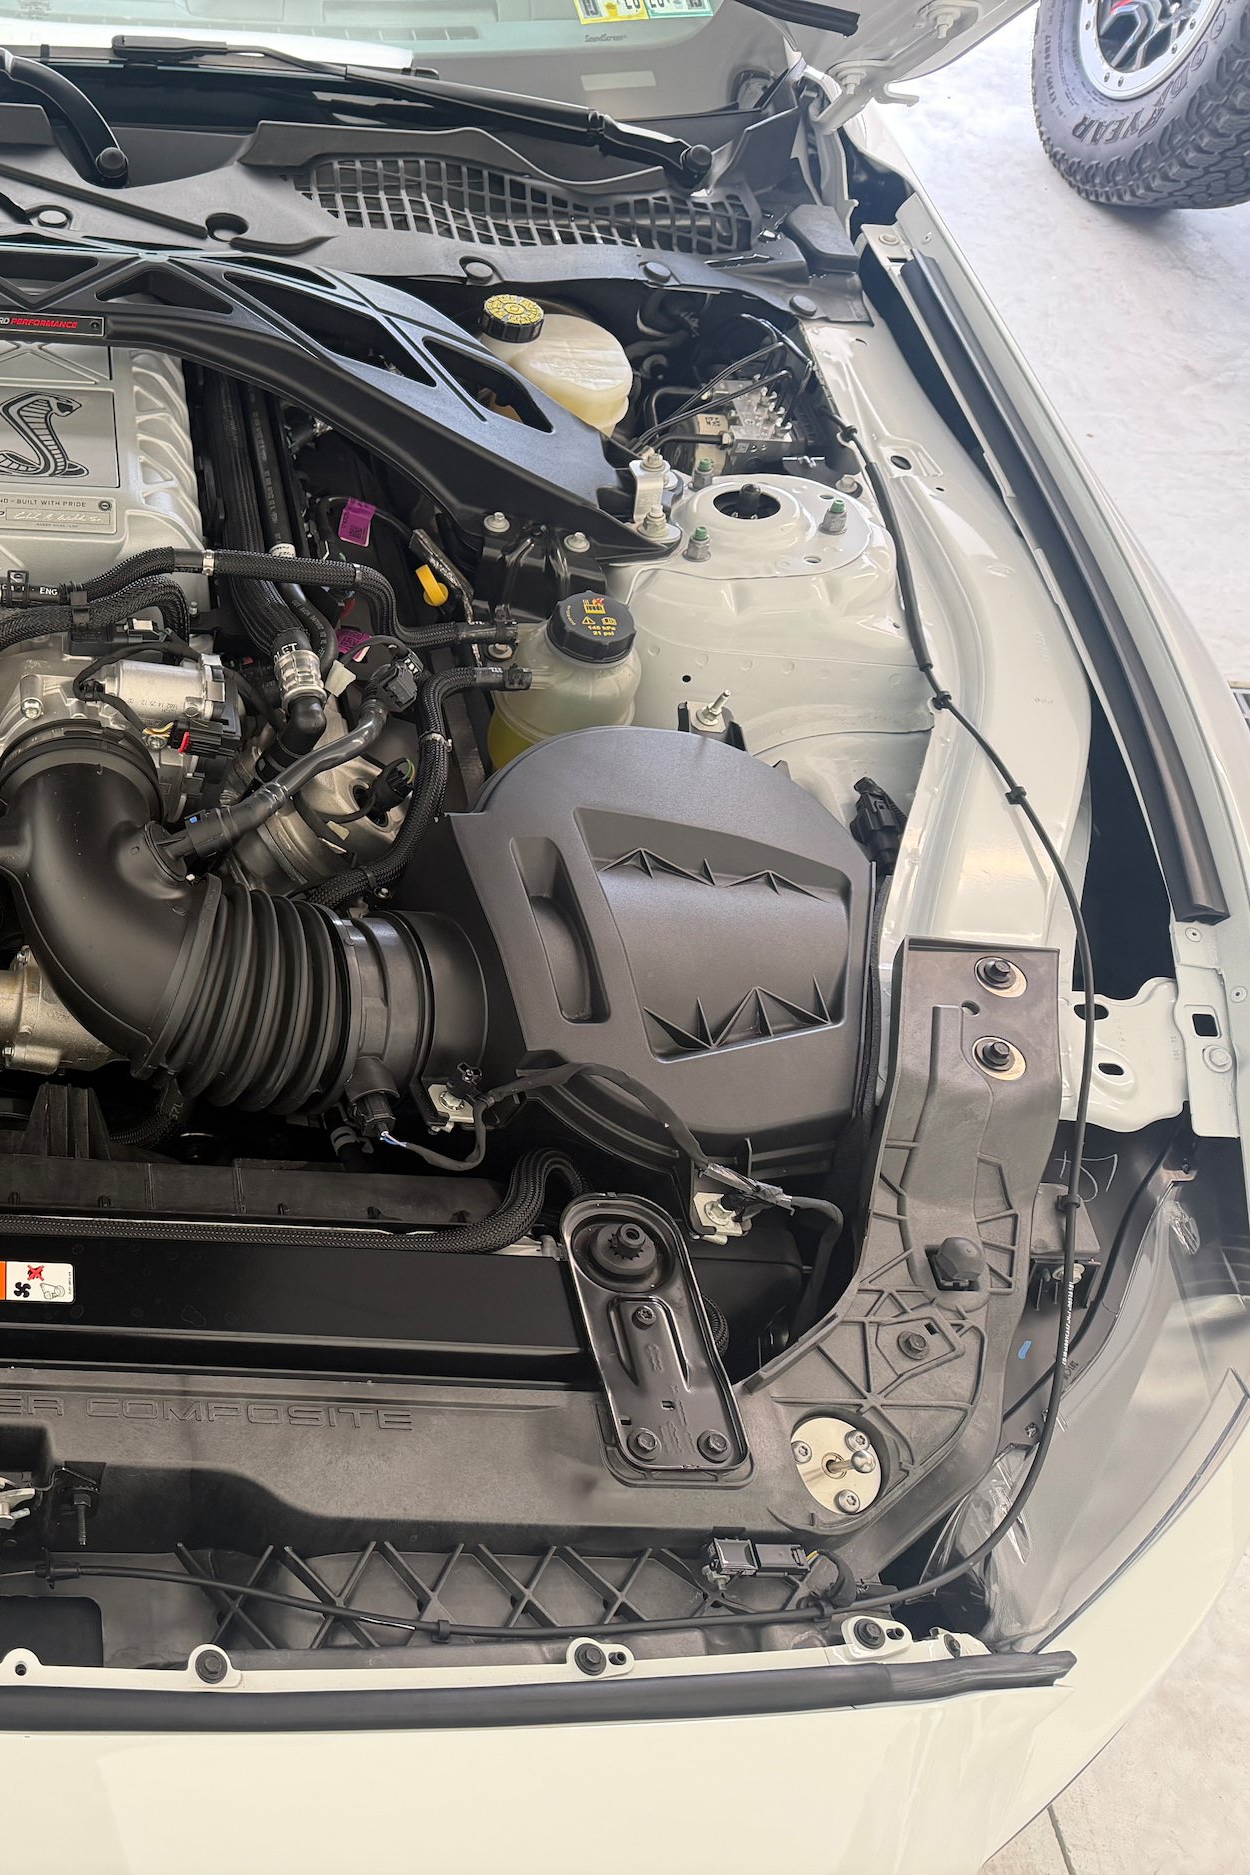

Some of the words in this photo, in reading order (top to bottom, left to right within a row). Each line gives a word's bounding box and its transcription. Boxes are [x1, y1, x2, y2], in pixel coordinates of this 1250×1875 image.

[10, 317, 79, 329] PERFORMANCE
[16, 498, 38, 506] BUILT
[39, 586, 59, 596] ENG
[85, 1398, 414, 1432] COMPOSITE
